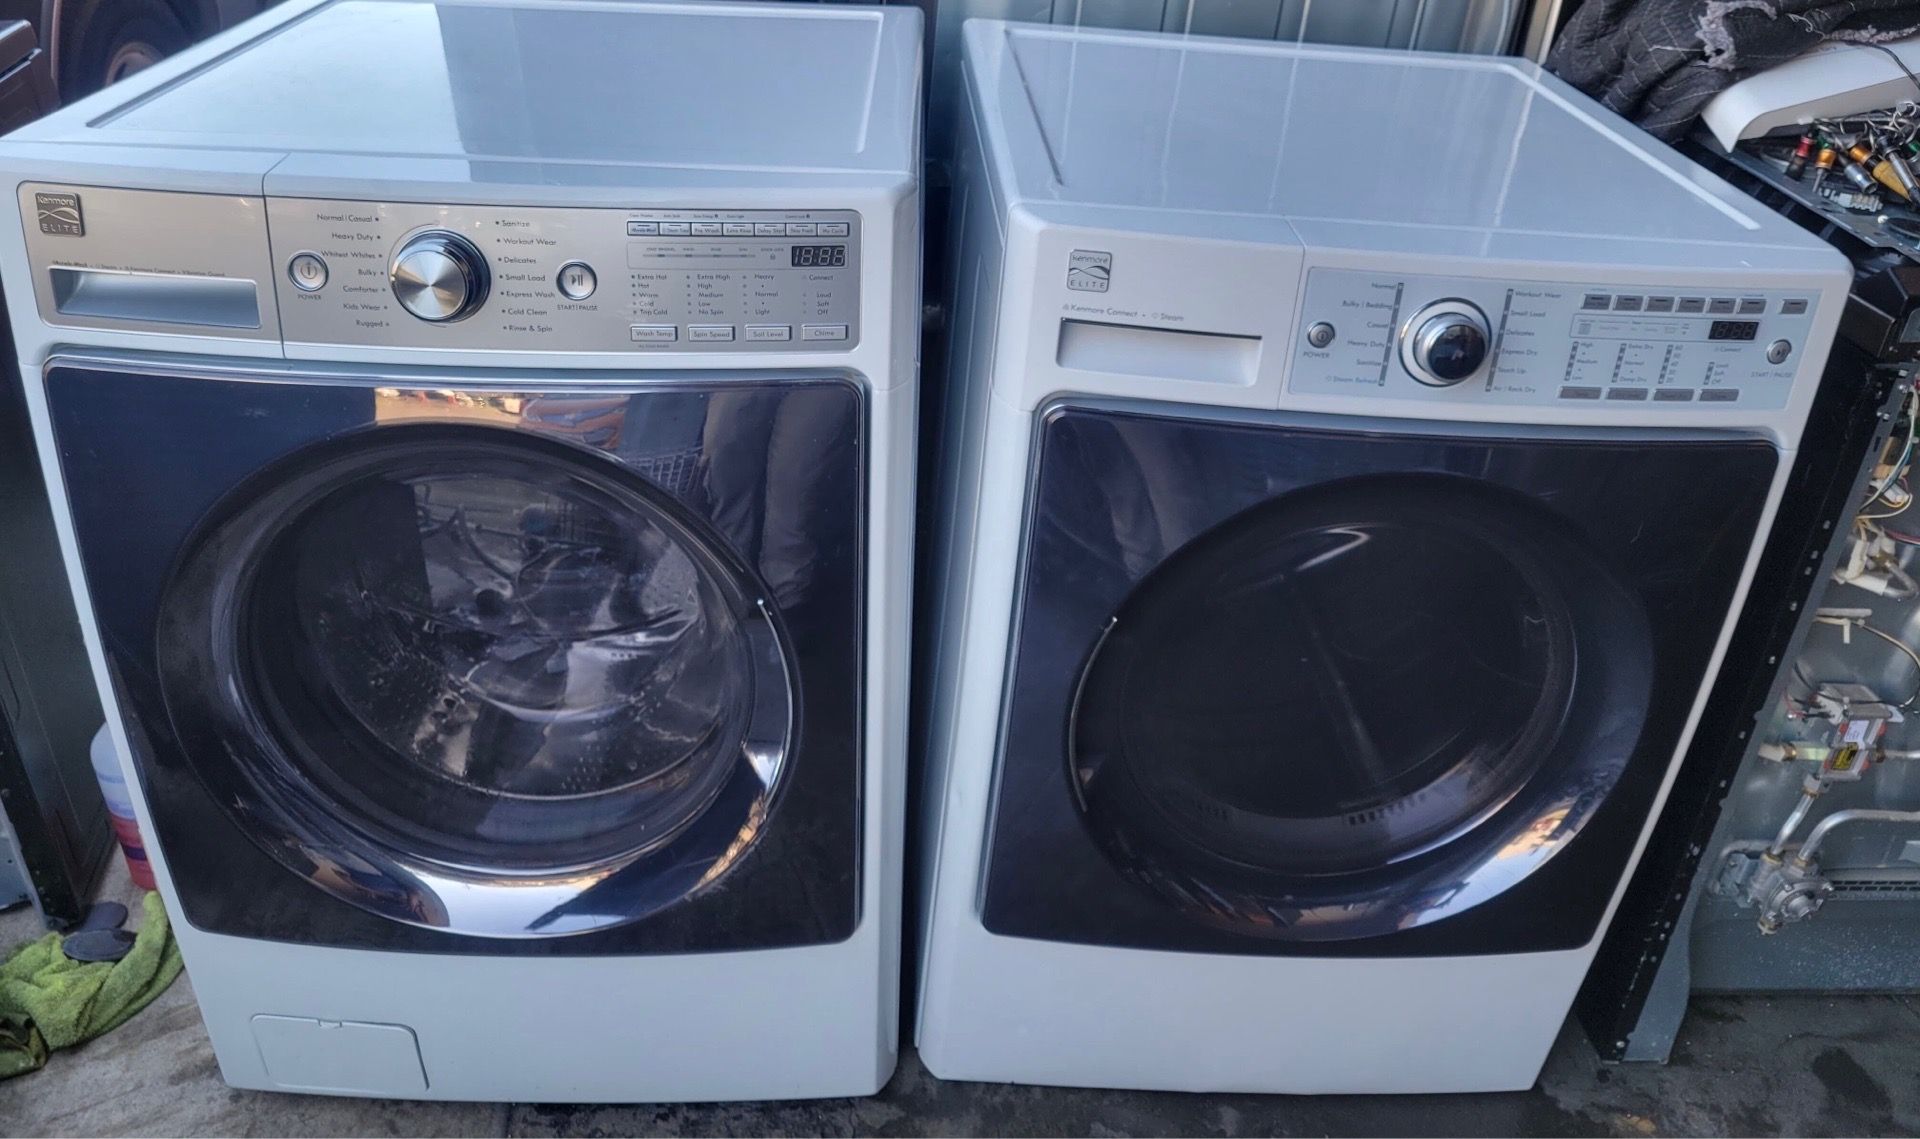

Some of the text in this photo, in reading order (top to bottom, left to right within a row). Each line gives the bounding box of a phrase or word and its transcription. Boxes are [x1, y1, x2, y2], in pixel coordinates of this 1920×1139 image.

[317, 214, 344, 222] Normal
[41, 223, 79, 234] ELITE
[332, 232, 374, 241] Heavy Duty
[536, 238, 557, 246] Wear
[1072, 254, 1108, 263] Kenmore
[358, 269, 377, 277] Bulky
[1070, 280, 1105, 289] ELITE
[506, 291, 533, 299] Express
[1070, 304, 1138, 317] Kenmore Connect
[356, 320, 383, 328] Rugged
